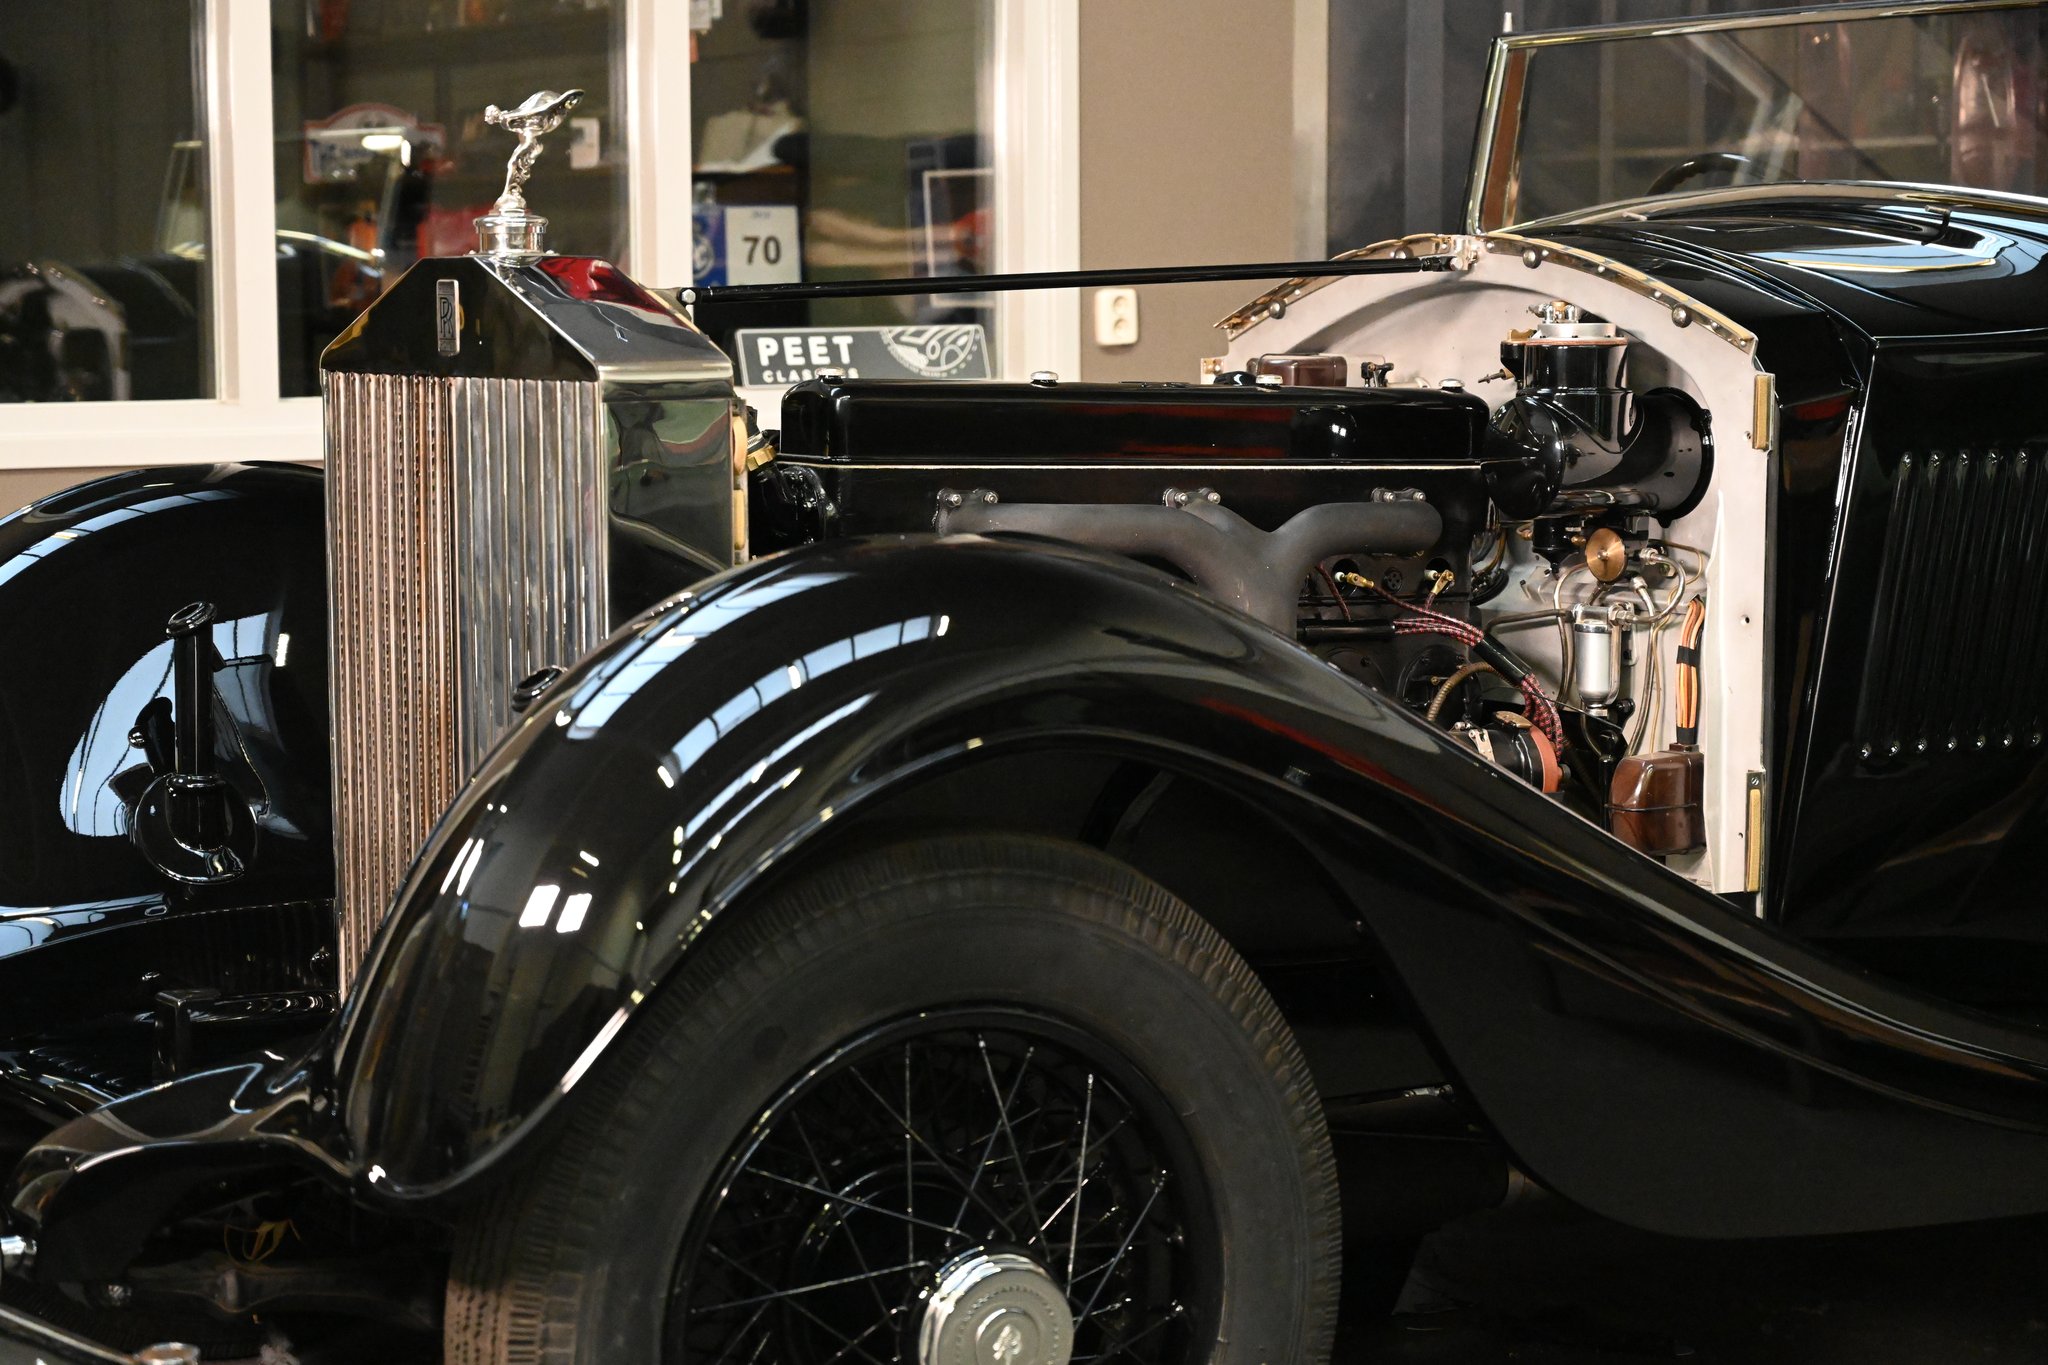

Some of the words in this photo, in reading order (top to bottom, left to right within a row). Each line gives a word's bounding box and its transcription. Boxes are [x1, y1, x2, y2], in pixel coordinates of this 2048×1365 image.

[742, 235, 782, 266] 70
[757, 335, 854, 366] PEET
[762, 367, 859, 383] CLASS
